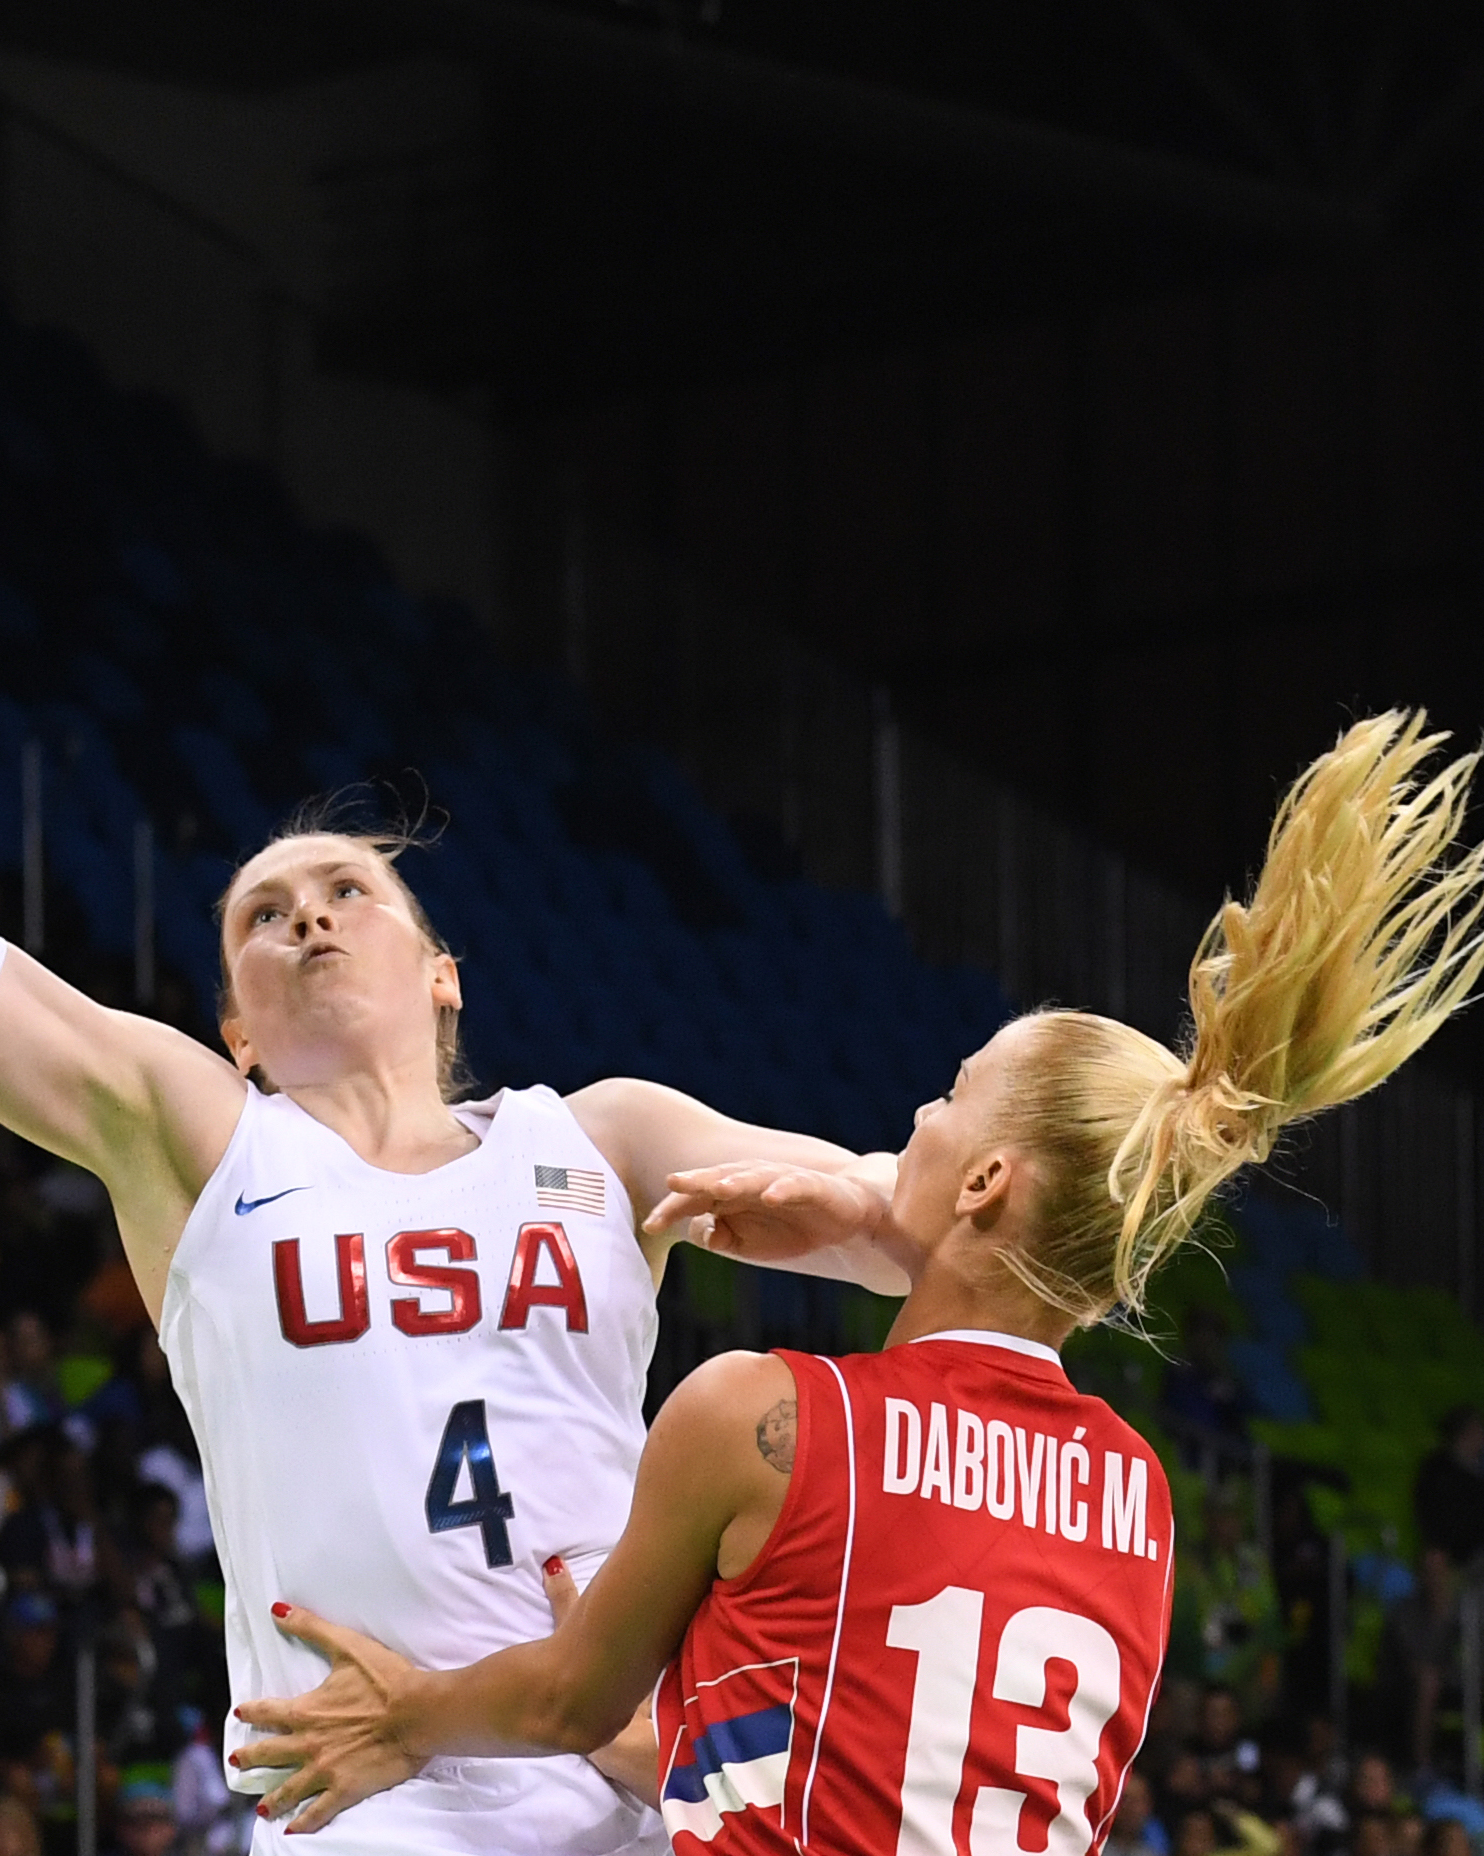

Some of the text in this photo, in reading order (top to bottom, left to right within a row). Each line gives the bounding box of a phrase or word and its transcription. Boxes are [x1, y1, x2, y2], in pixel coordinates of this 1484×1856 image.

[271, 1221, 590, 1349] USA
[423, 1398, 516, 1570] 4
[881, 1396, 1159, 1562] DABOVIĆ M.
